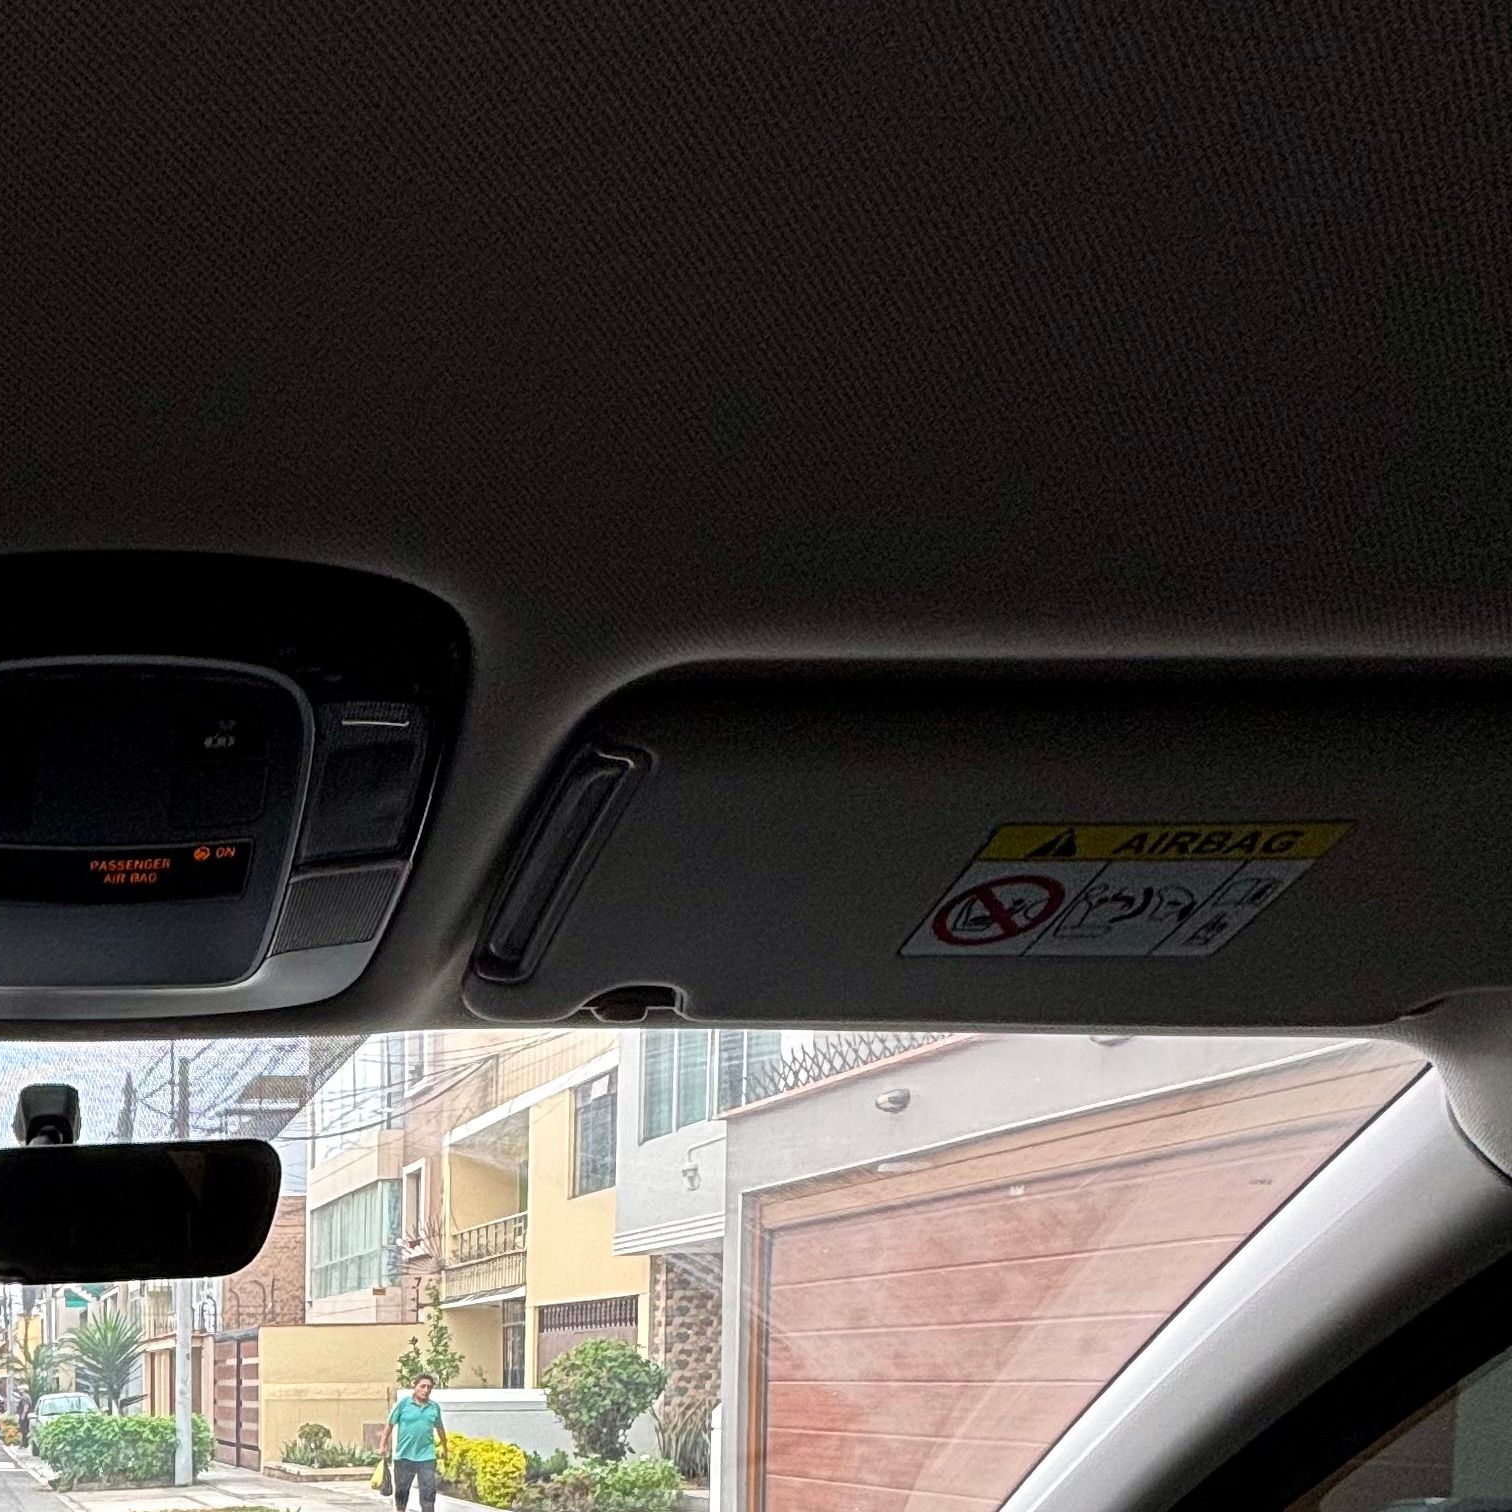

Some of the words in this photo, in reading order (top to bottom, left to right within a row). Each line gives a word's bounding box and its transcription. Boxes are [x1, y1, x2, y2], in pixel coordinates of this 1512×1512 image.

[1112, 830, 1305, 854] AIRBAG
[215, 847, 236, 858] ON
[90, 859, 172, 871] PASSENGER
[103, 873, 126, 884] AIR
[129, 873, 158, 884] BAG
